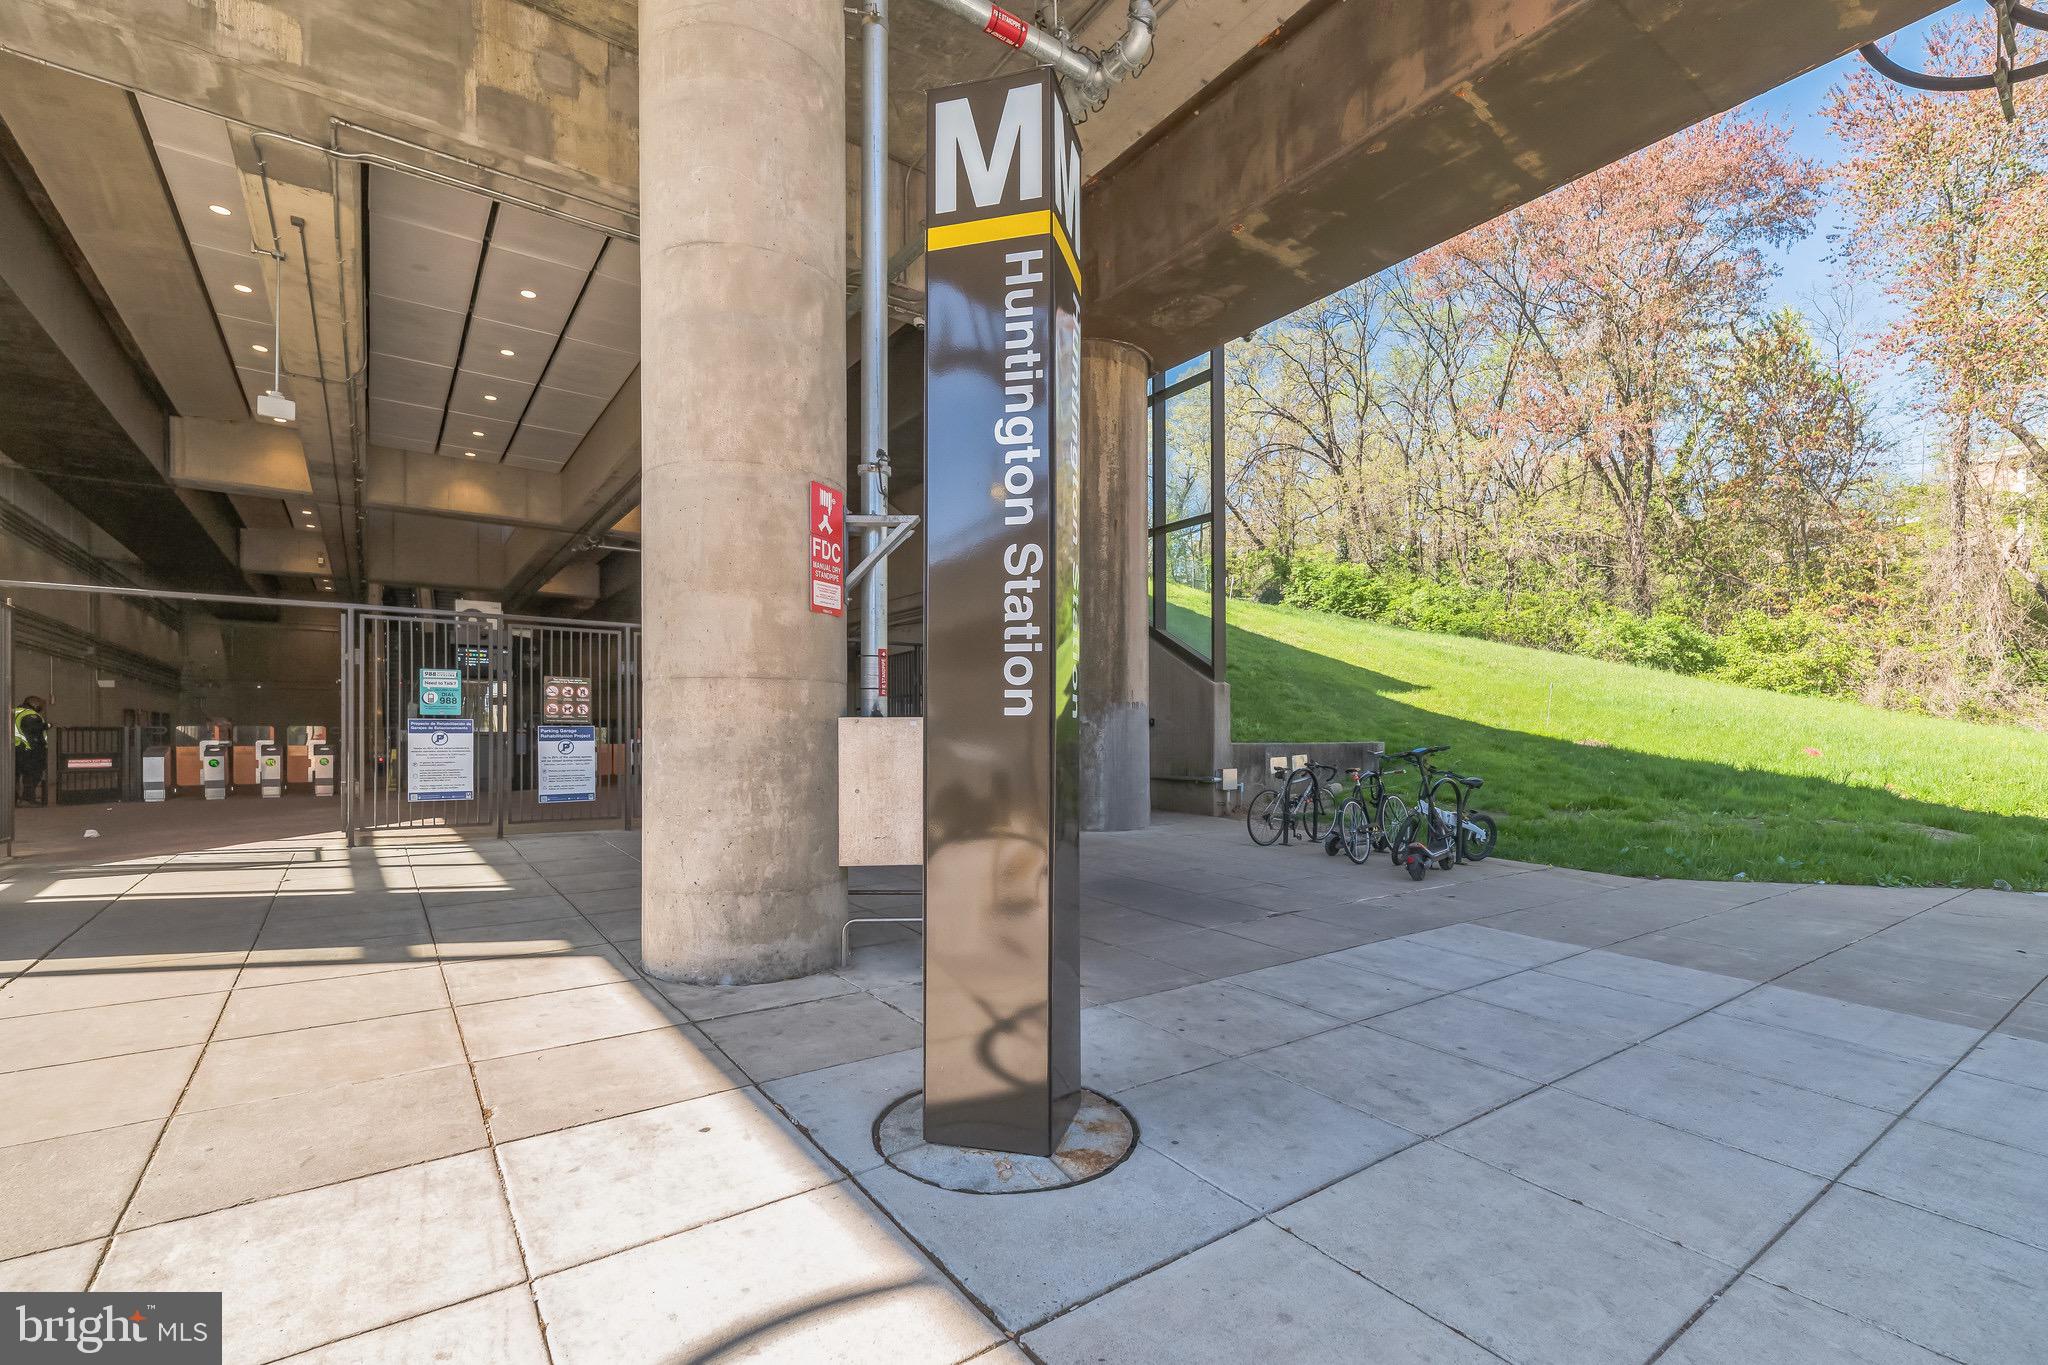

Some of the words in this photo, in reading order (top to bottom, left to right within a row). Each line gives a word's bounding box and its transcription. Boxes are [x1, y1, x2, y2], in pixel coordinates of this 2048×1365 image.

[935, 82, 1043, 214] M
[1053, 92, 1081, 260] M
[994, 249, 1044, 526] Huntington
[1070, 292, 1081, 546] Huntington
[812, 536, 841, 563] FDC
[812, 560, 831, 572] MANUAL
[831, 565, 841, 574] DRY
[815, 569, 840, 582] STANDPIPE
[439, 696, 458, 705] 988
[1004, 543, 1044, 717] Station
[1071, 561, 1080, 718] Station
